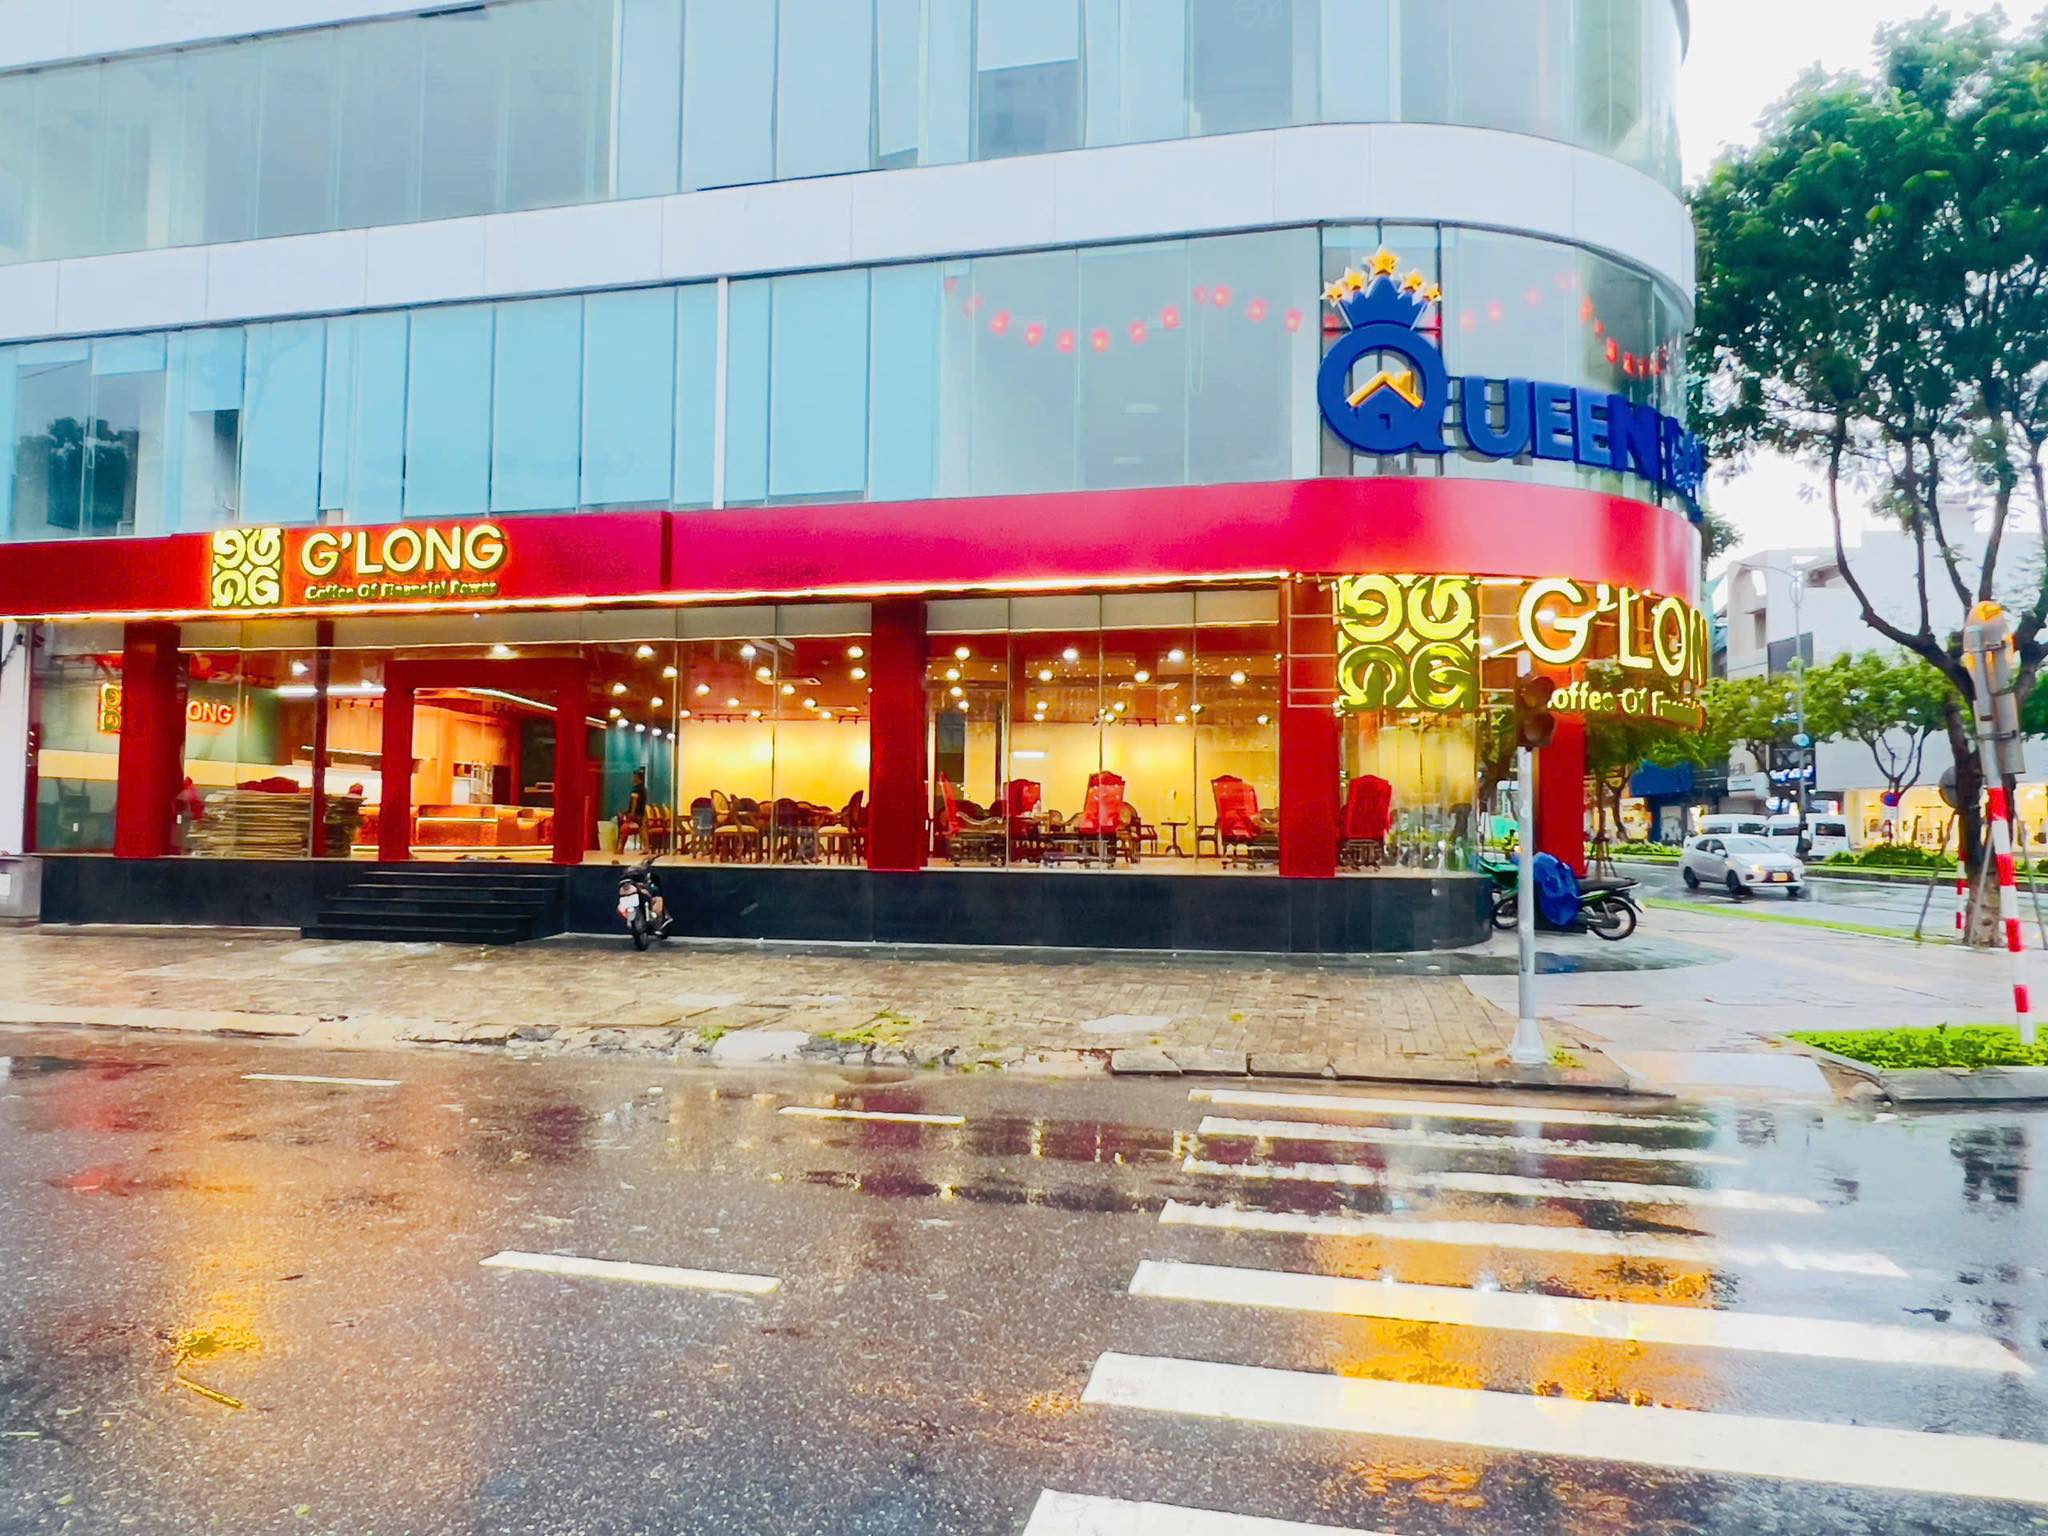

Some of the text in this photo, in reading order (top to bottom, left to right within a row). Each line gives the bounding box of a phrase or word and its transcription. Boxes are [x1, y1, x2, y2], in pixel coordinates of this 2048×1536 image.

[301, 524, 505, 577] G'LONG
[304, 584, 354, 600] Coffee
[357, 582, 378, 597] Of
[1547, 681, 1615, 713] offee
[187, 701, 232, 724] ONG
